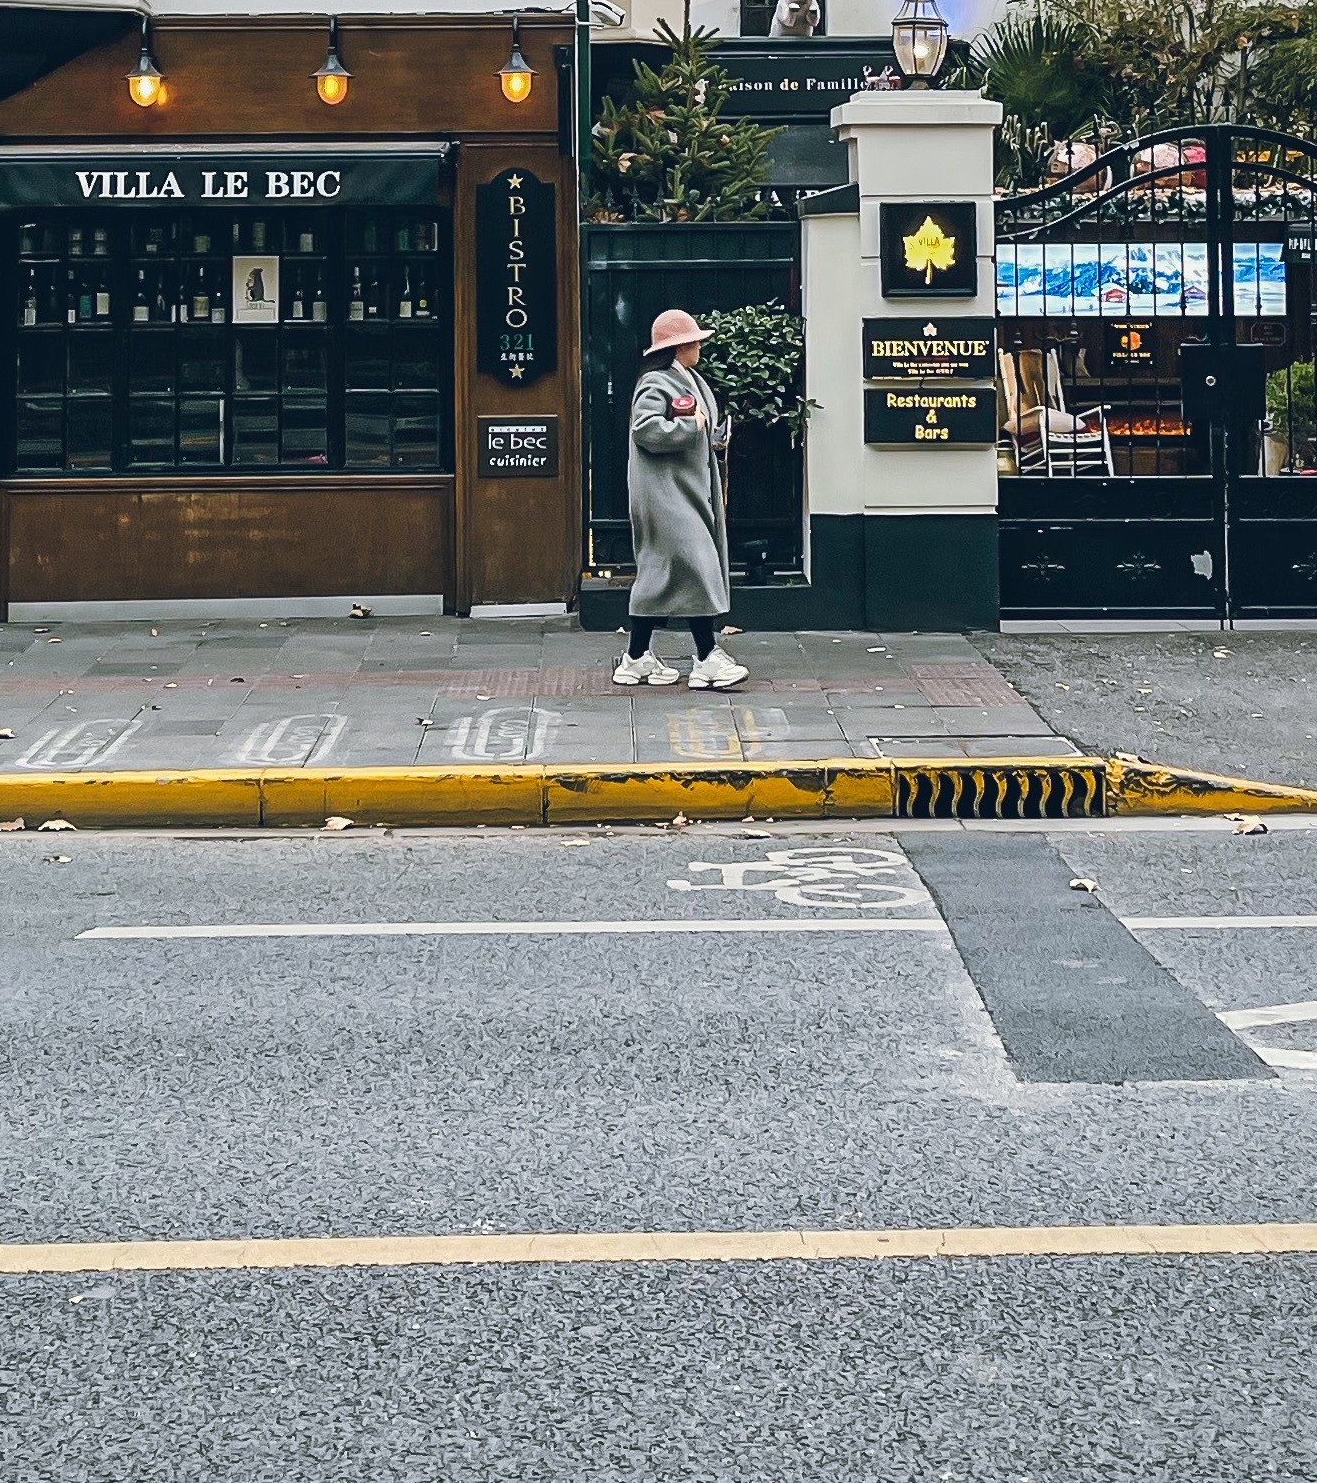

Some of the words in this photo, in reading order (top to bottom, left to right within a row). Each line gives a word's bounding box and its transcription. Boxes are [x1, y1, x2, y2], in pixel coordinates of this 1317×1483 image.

[779, 78, 800, 91] de
[75, 170, 185, 199] VILLA
[200, 171, 249, 198] LE
[265, 170, 342, 198] BEC
[504, 196, 529, 329] BISTRO
[499, 333, 535, 351] 321
[886, 392, 977, 409] Restaurants
[925, 409, 938, 424] &
[914, 424, 950, 440] Bars
[488, 433, 505, 450] le
[510, 433, 547, 450] bec
[489, 453, 547, 467] cuisinier
